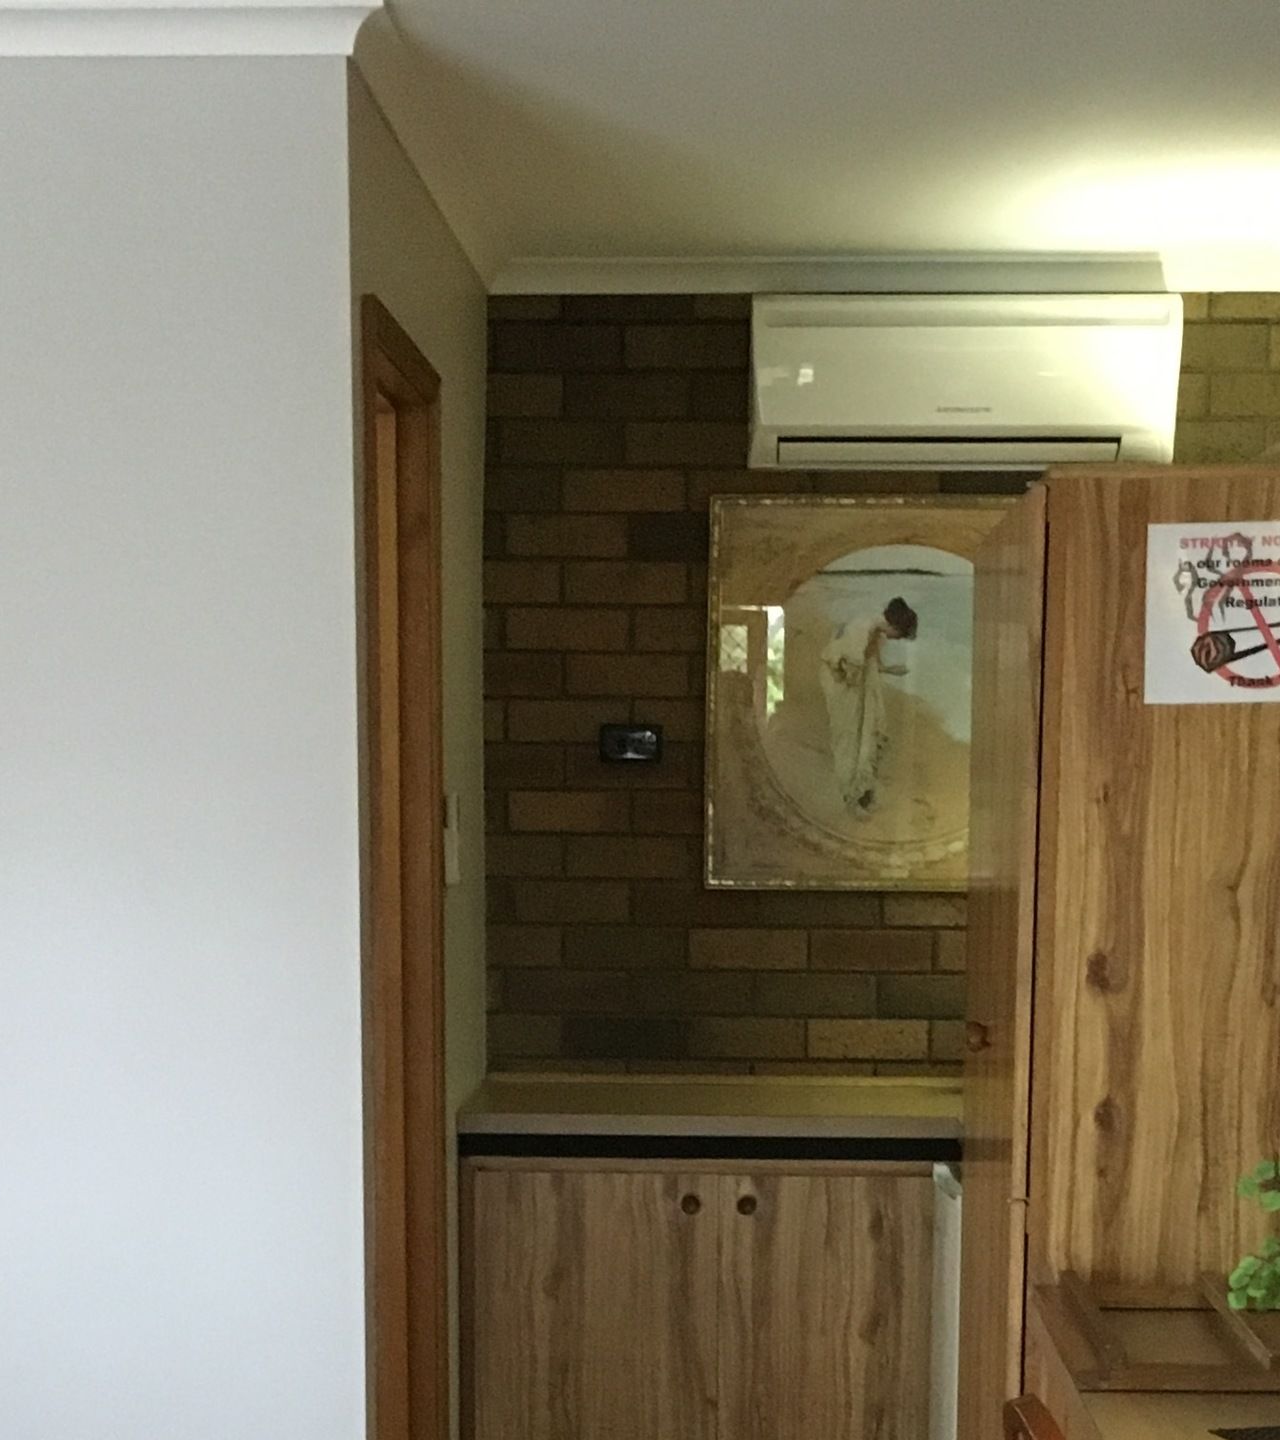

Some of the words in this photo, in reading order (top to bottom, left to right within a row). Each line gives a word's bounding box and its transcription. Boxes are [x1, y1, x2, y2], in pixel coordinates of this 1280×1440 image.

[1197, 558, 1220, 569] our
[1226, 557, 1272, 568] rooms
[1229, 675, 1273, 687] Thank
